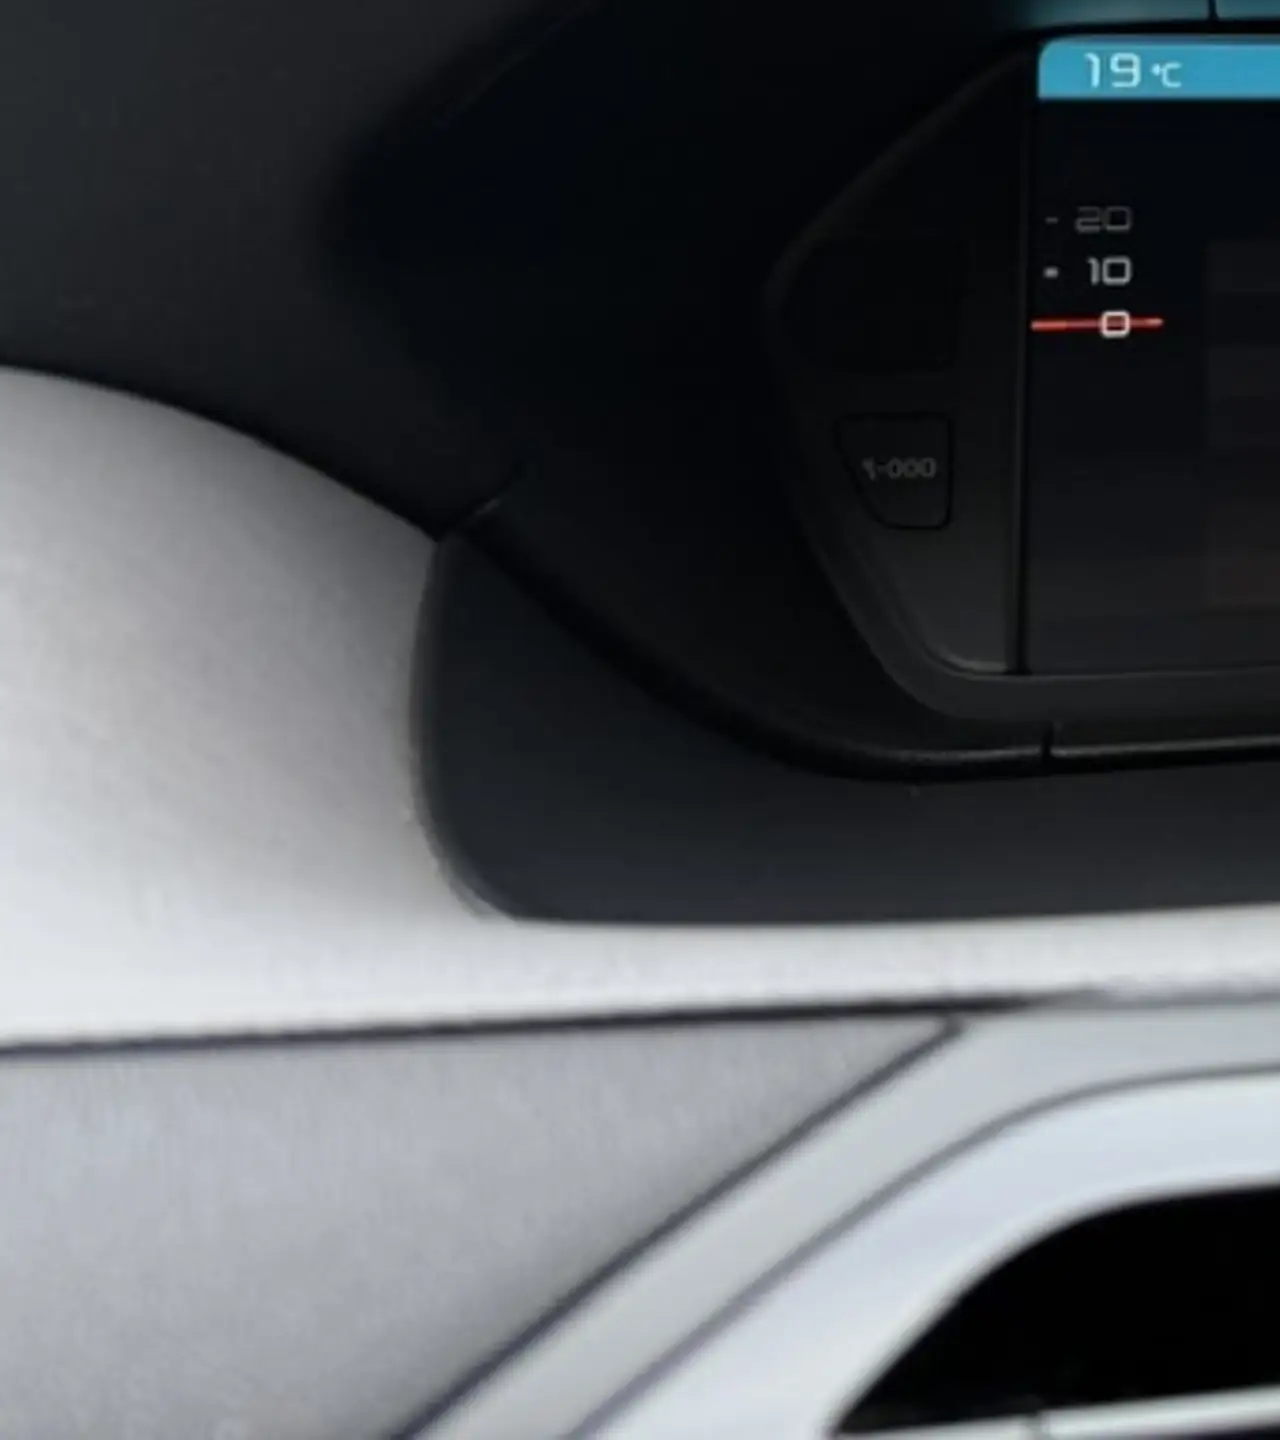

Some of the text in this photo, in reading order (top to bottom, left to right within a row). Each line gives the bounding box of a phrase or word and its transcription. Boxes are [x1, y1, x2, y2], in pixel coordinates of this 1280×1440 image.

[1085, 52, 1142, 89] 19
[1075, 206, 1132, 232] 20
[1087, 257, 1132, 285] 10
